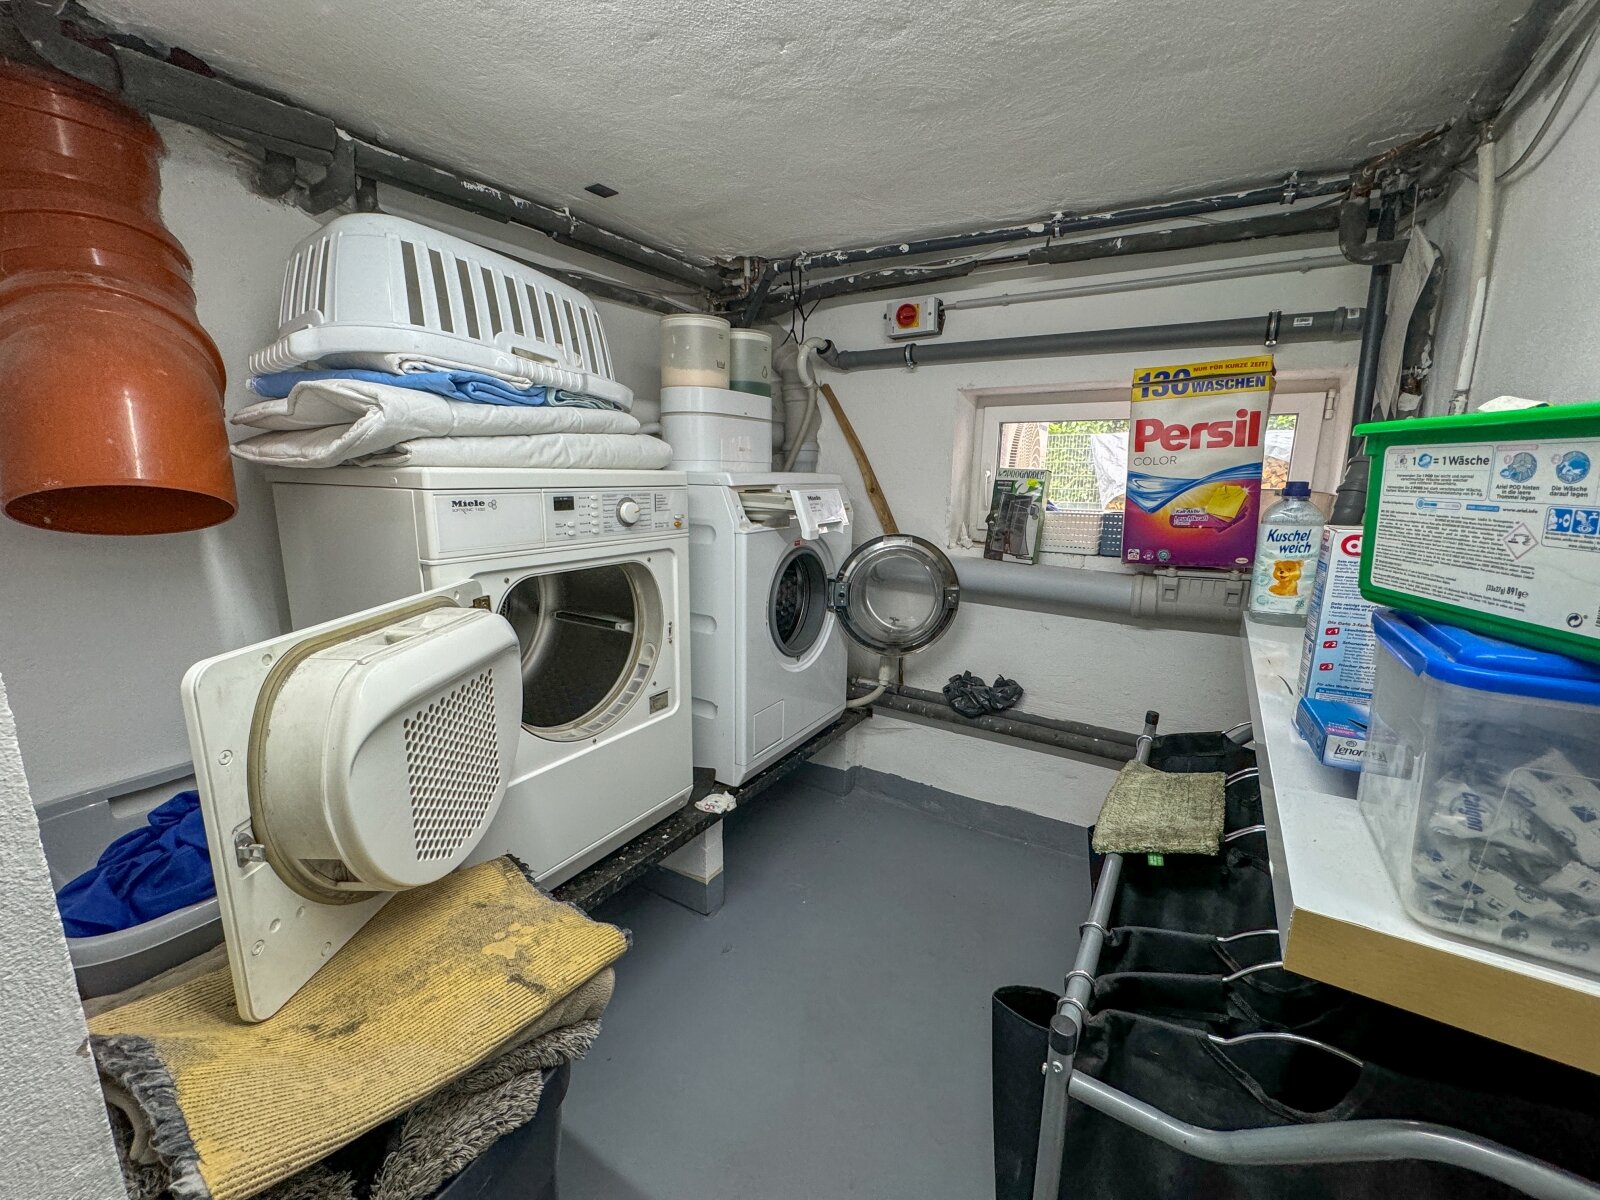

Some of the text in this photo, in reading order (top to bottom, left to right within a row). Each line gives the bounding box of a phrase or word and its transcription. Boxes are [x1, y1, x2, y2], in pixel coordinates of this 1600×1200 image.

[1210, 363, 1223, 371] FÜR
[1225, 362, 1248, 370] KURZE
[1250, 360, 1268, 368] ZEIT!
[1138, 368, 1191, 398] 130
[1135, 408, 1262, 452] Persil
[1133, 455, 1178, 467] COLOR
[1448, 455, 1490, 466] Wäsche
[451, 499, 486, 508] Miele
[1266, 528, 1313, 543] Kuschel
[1279, 541, 1312, 554] weich
[1334, 744, 1364, 757] Lenor
[1459, 792, 1486, 832] Calgon
